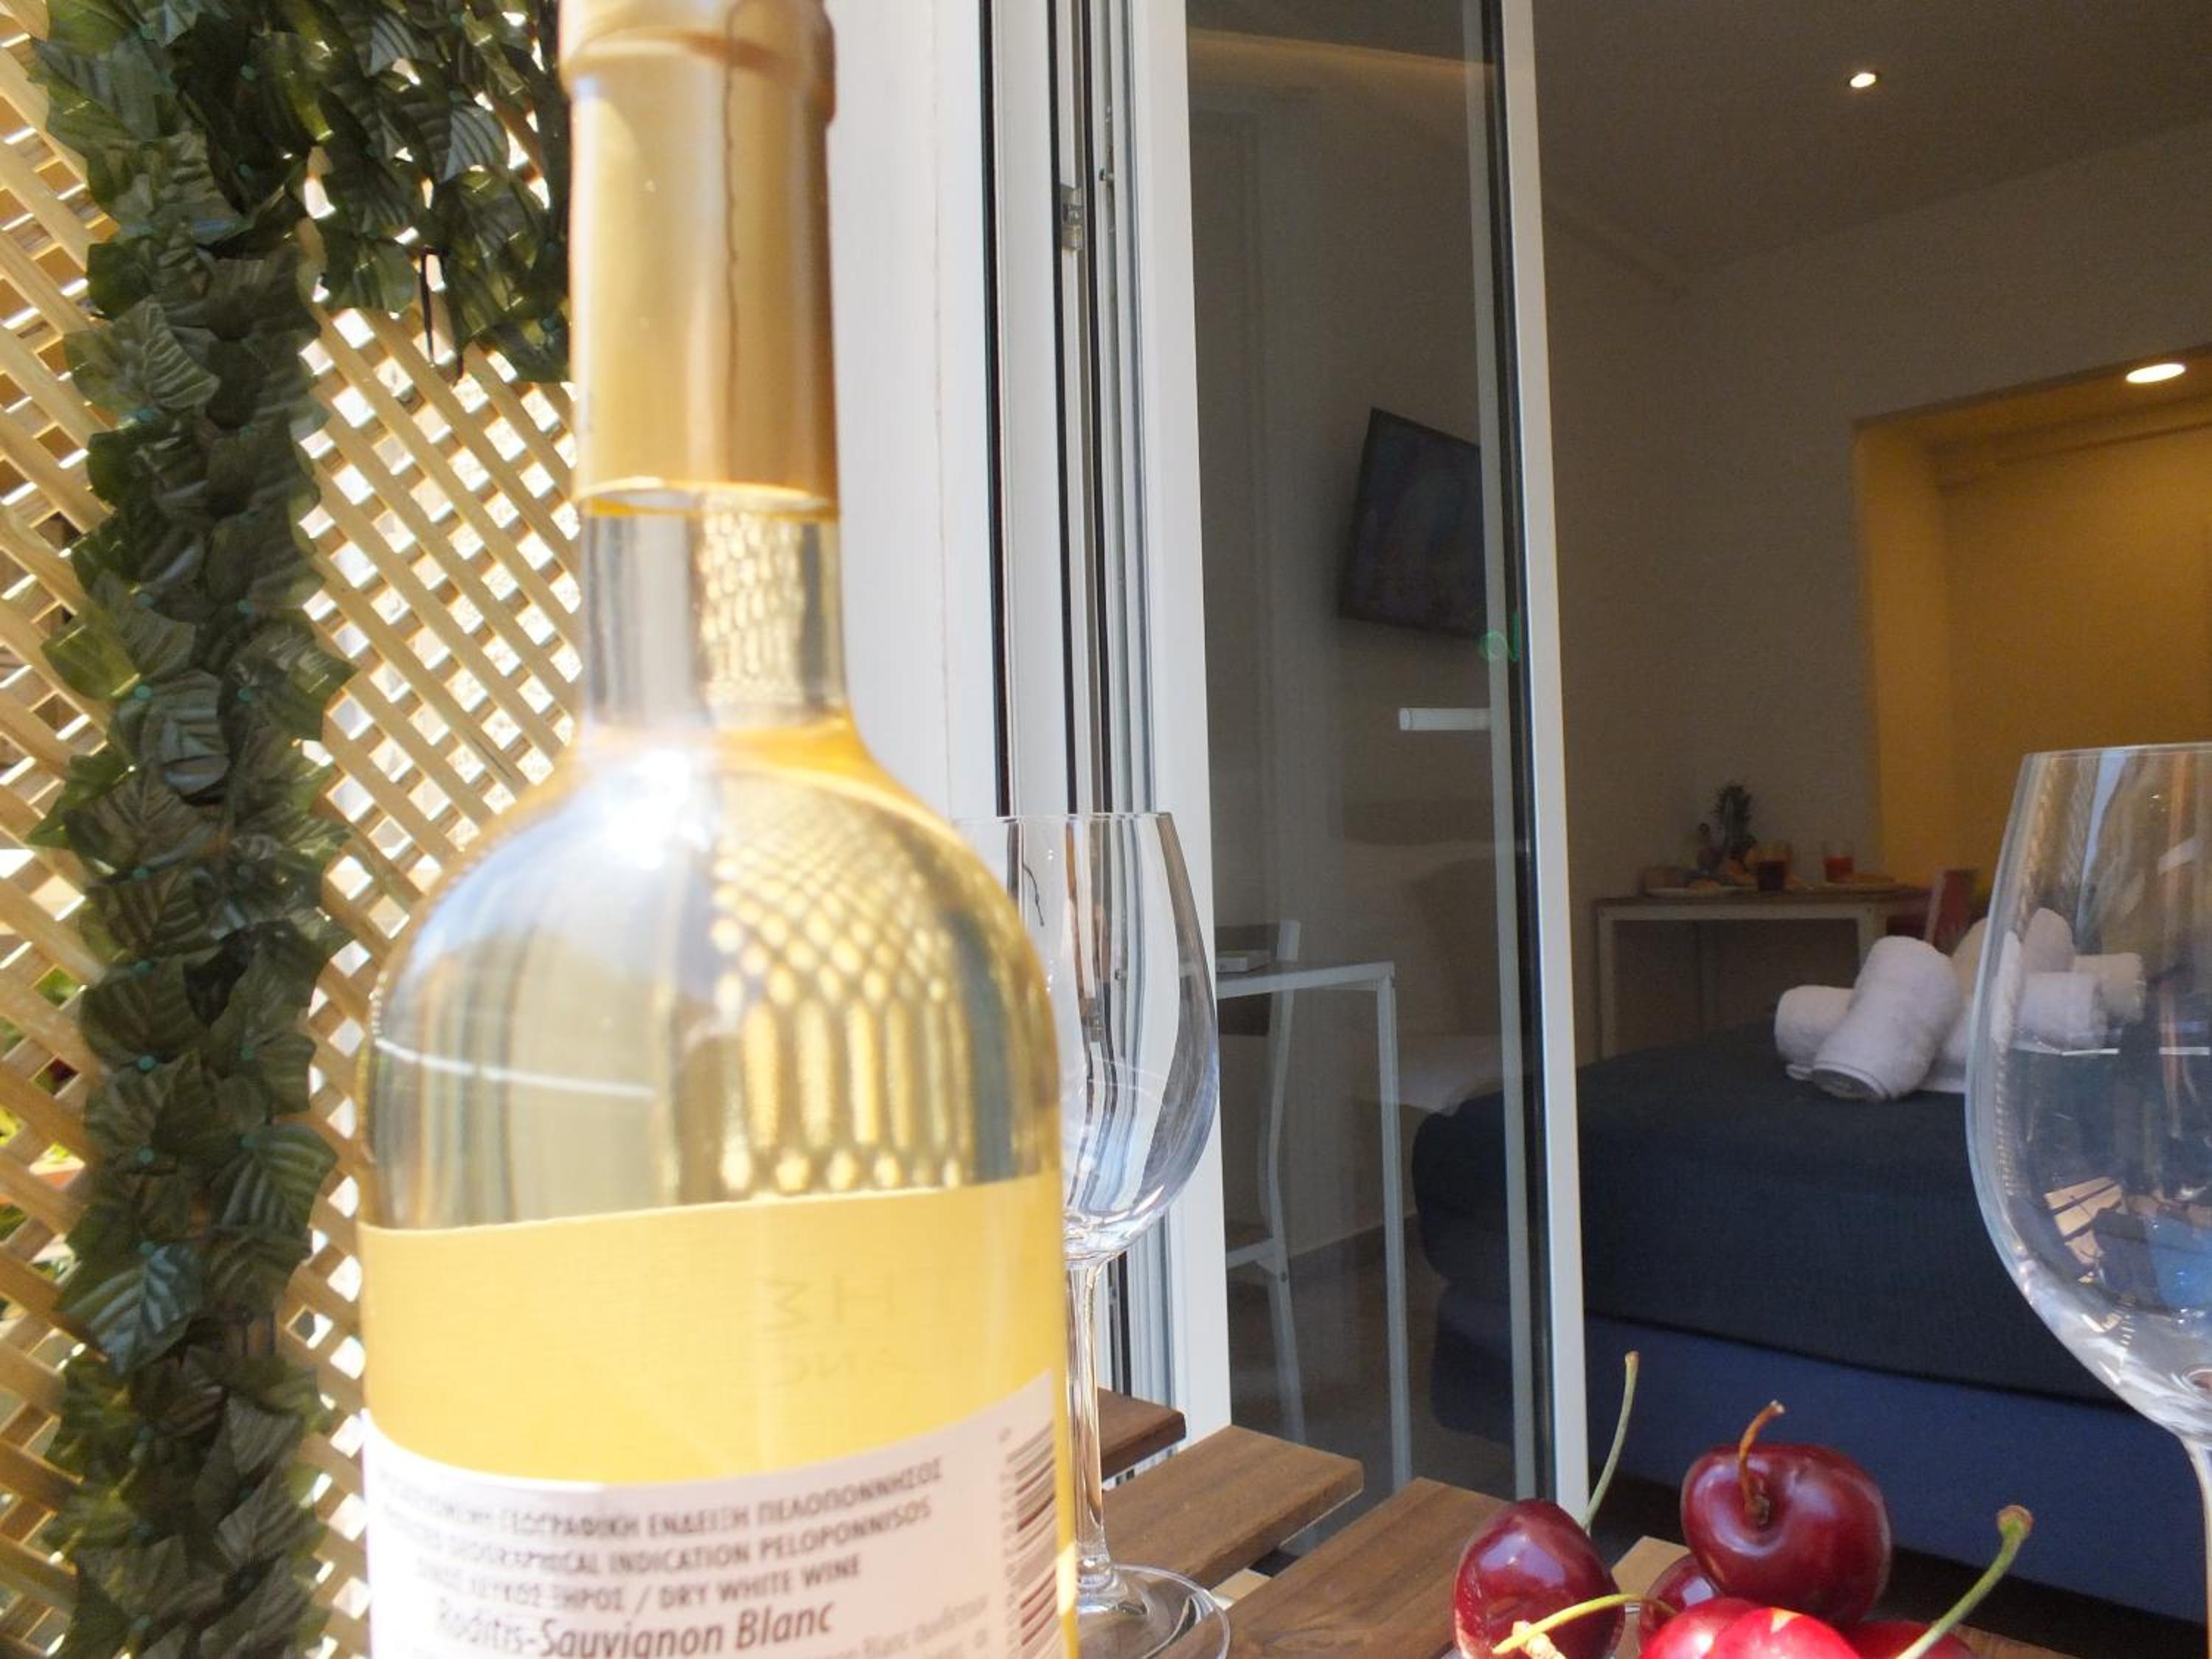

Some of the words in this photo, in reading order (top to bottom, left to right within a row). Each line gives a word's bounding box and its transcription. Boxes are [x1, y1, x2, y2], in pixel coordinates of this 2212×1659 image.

[608, 1543, 751, 1575] INDICATION
[758, 1494, 933, 1561] PELOPONNISOS
[658, 1582, 709, 1610] DRY
[716, 1567, 793, 1603] WHITE
[800, 1550, 861, 1587] WINE
[735, 1601, 835, 1652] Blanc
